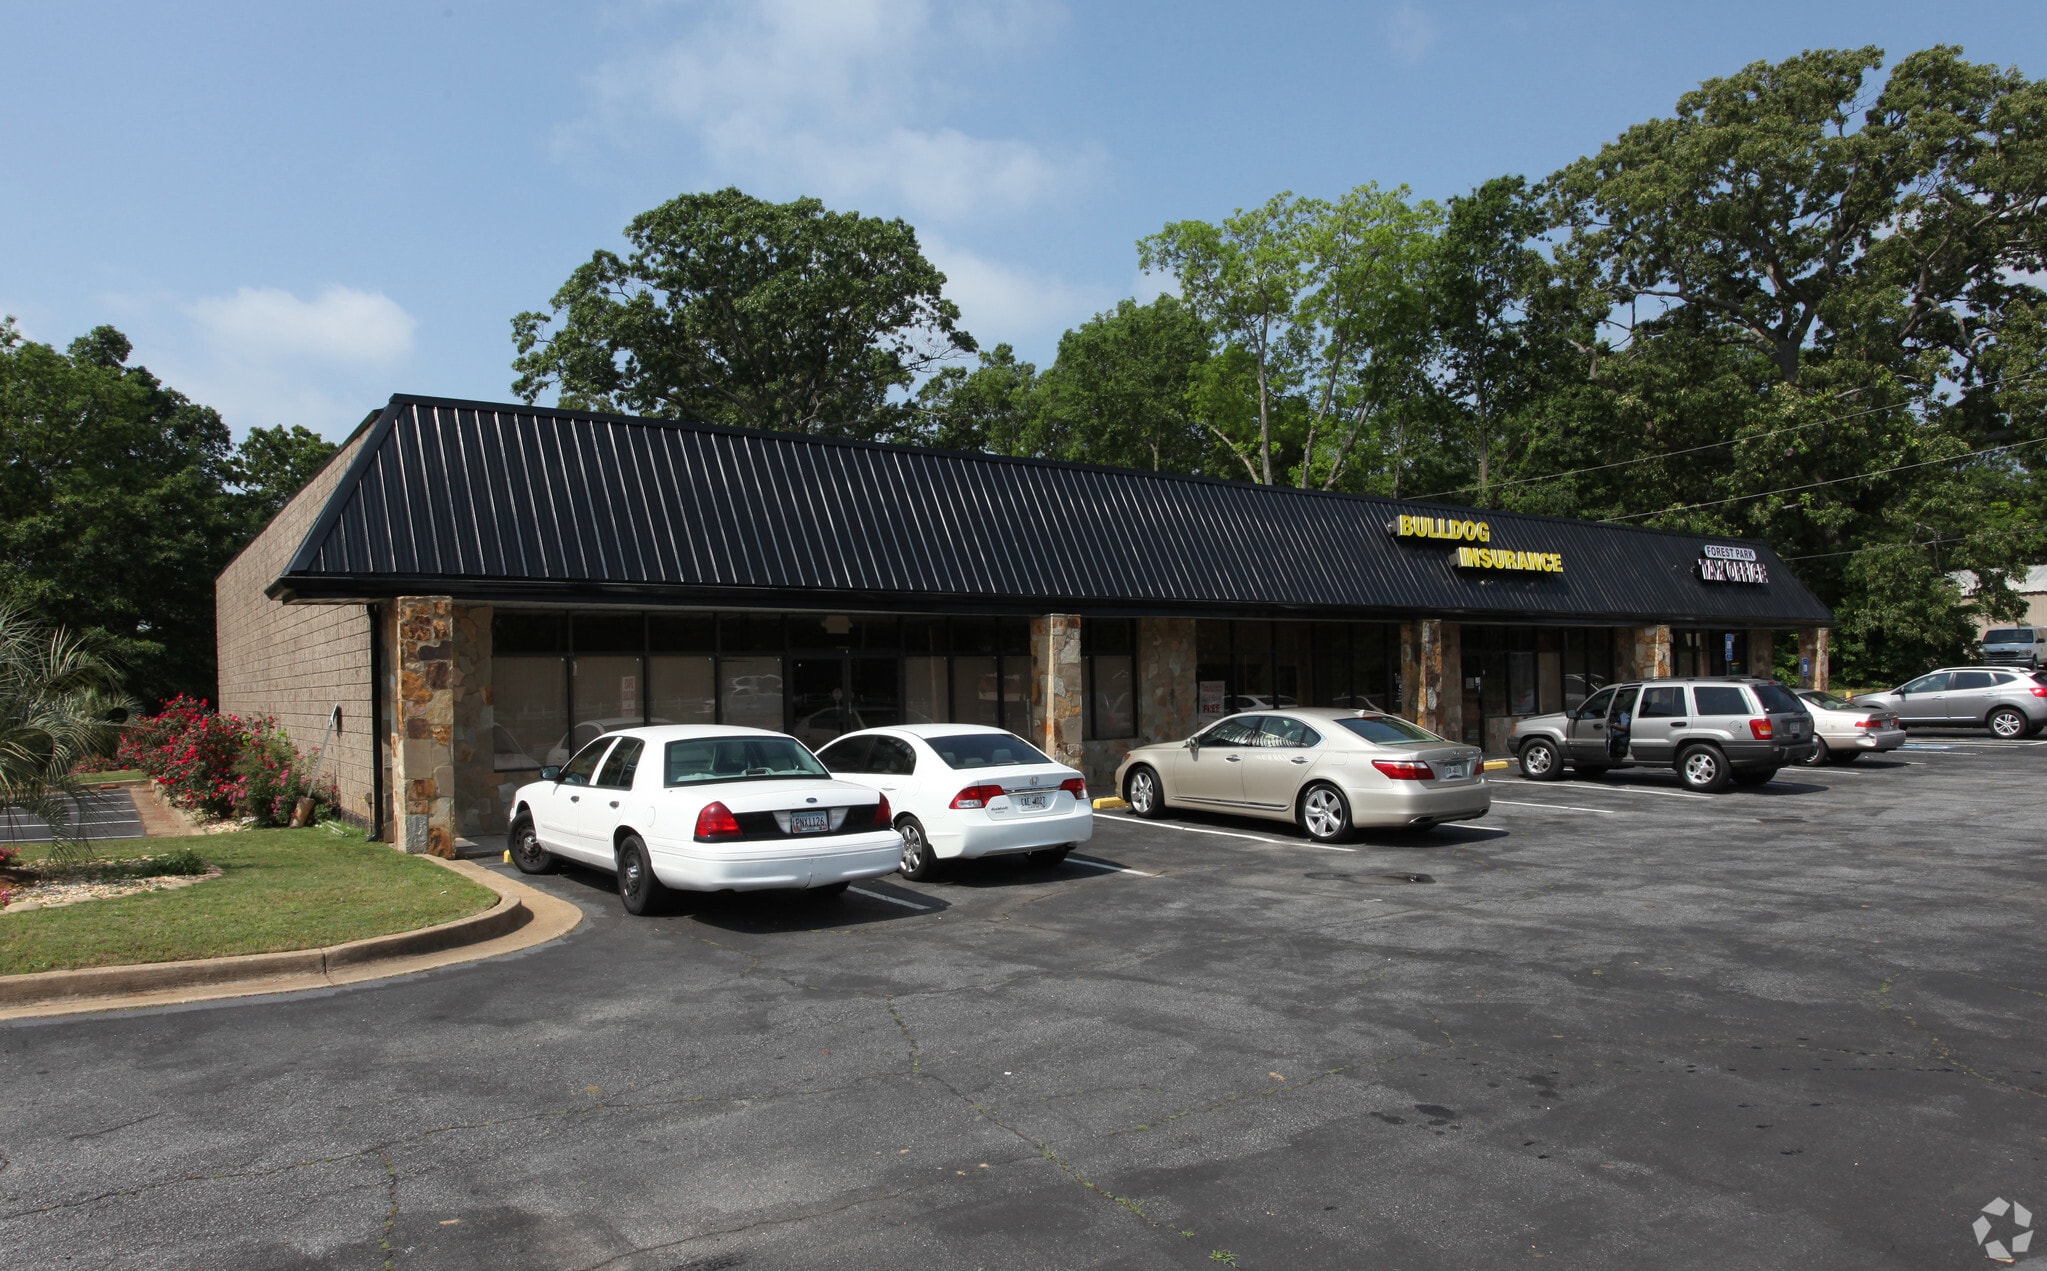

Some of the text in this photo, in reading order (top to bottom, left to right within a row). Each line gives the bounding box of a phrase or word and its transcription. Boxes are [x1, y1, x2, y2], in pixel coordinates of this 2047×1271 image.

[1398, 514, 1490, 542] BULLDOG
[1458, 546, 1564, 573] INSURANCE
[1706, 546, 1755, 559] FOREST PARK
[1698, 558, 1769, 583] TAX OFFICE
